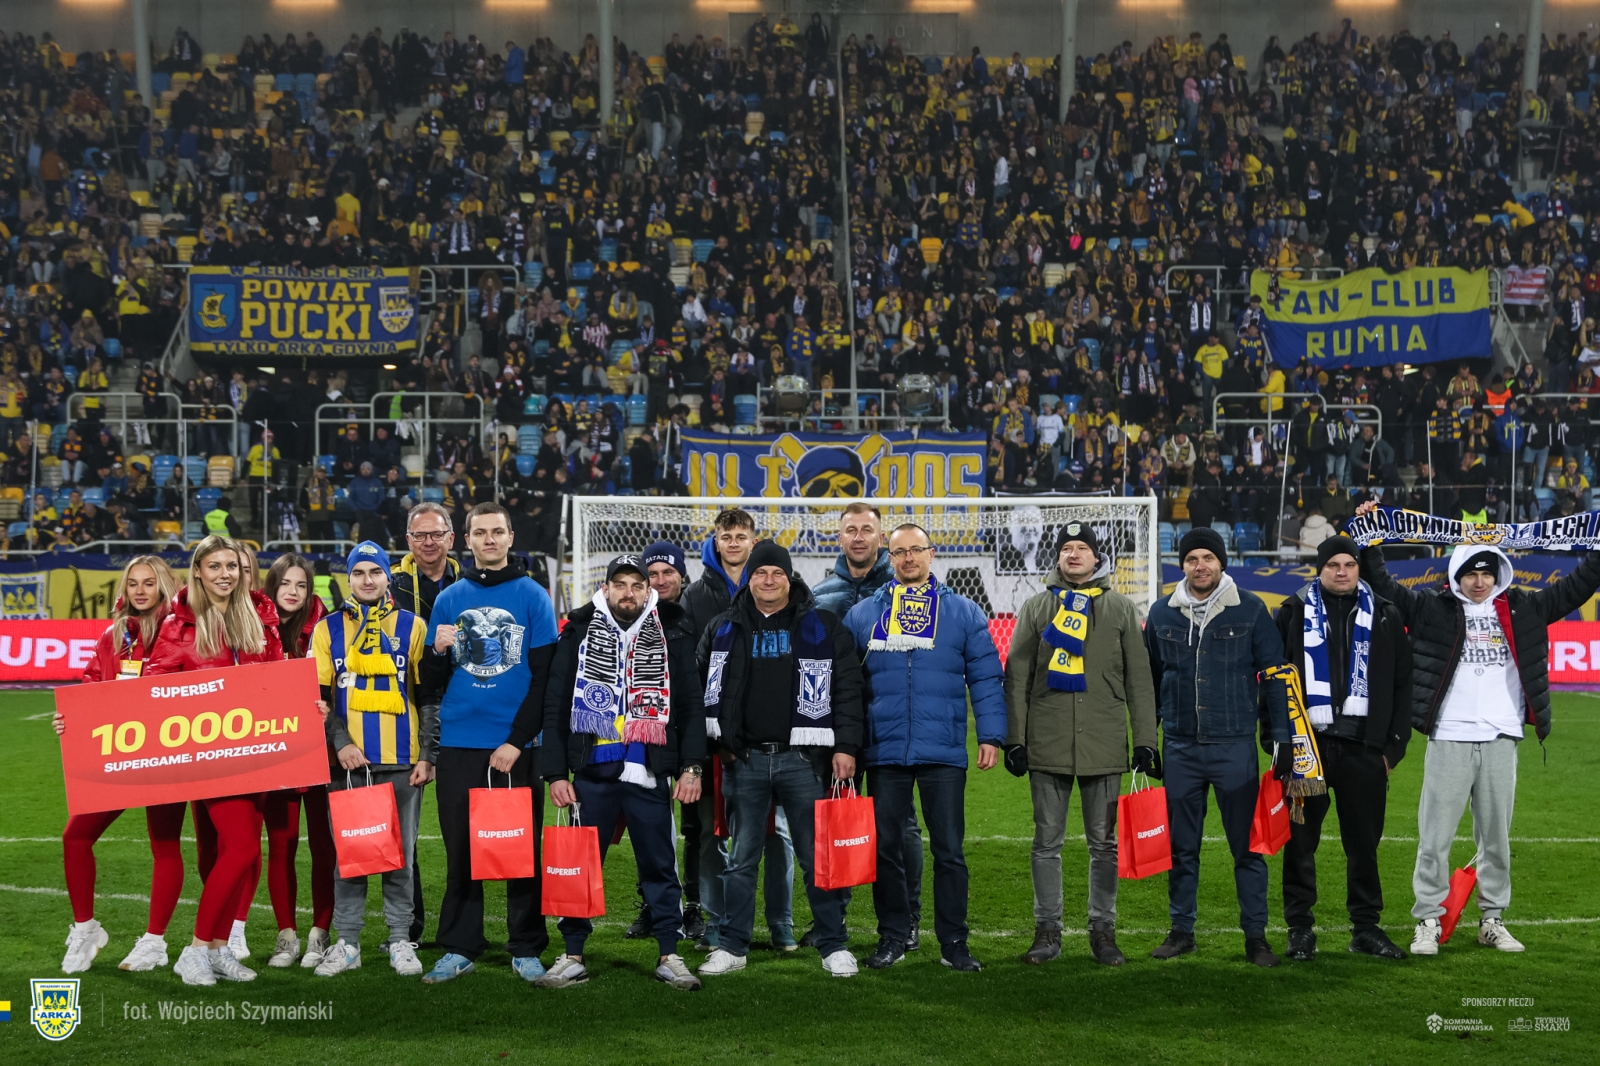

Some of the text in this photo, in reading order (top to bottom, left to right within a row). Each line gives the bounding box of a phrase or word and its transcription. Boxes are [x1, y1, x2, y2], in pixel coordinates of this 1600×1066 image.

[242, 279, 372, 302] POWIAT
[239, 301, 372, 340] PUCKI
[213, 340, 399, 356] TYLKO ARKA GDYNIA
[1306, 324, 1427, 358] RUMIA
[1349, 508, 1463, 538] ARKA GDYNIA
[1541, 513, 1591, 540] LECH
[1416, 532, 1465, 543] wielkiego
[1063, 616, 1081, 631] 80
[150, 678, 225, 698] SUPERBET
[92, 720, 146, 756] 10
[104, 741, 287, 773] SUPERGAME: POPRZECZKA
[341, 822, 387, 838] SUPERBET
[477, 828, 525, 839] SUPERBET
[1137, 824, 1165, 839] SUPERBET
[833, 835, 870, 847] SUPERBET
[546, 866, 581, 876] SUPERBET
